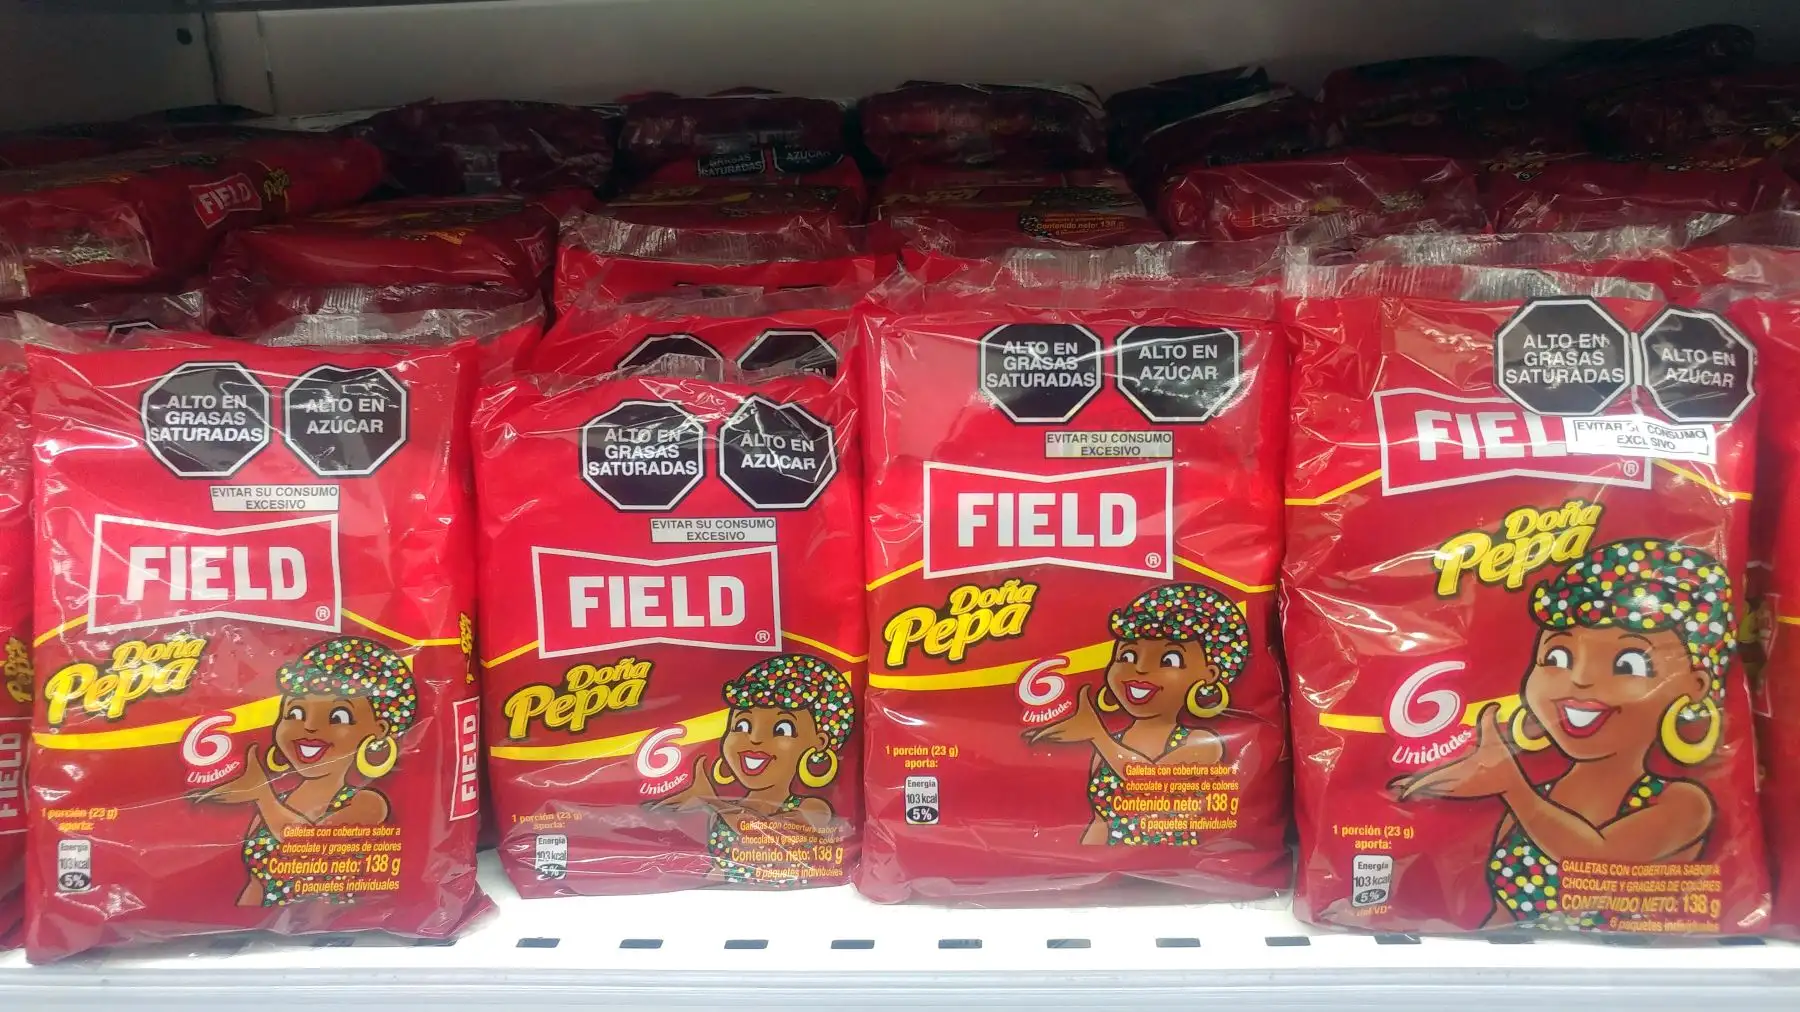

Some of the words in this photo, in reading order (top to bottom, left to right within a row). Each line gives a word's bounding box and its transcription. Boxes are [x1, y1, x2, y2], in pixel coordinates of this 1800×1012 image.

[198, 182, 252, 214] FIELD
[1003, 341, 1048, 355] ALTO
[1054, 342, 1078, 355] EN
[1523, 333, 1572, 349] ALTO
[1579, 333, 1606, 349] EN
[1139, 345, 1188, 360] ALTO
[1192, 345, 1218, 359] EN
[1524, 351, 1605, 366] GRASAS
[1661, 347, 1708, 363] ALTO
[1712, 351, 1736, 366] EN
[1004, 356, 1078, 370] GRASAS
[1140, 362, 1218, 381] AZÚCAR
[1505, 368, 1625, 384] SATURADAS
[986, 373, 1096, 388] SATURADAS
[167, 395, 216, 409] ALTO
[222, 395, 247, 409] EN
[306, 398, 353, 413] ALTO
[358, 398, 385, 413] EN
[165, 411, 246, 426] GRASAS
[306, 415, 384, 434] AZÚCAR
[150, 427, 263, 442] SATURADAS
[604, 428, 651, 443] ALTO
[657, 428, 681, 442] EN
[1047, 433, 1088, 444] EVITAR
[1091, 433, 1107, 444] SU
[1110, 433, 1172, 444] CONSUMO
[1415, 409, 1567, 461] FIEL
[1576, 421, 1623, 431] EVITAR
[1646, 424, 1707, 441] CONSUMO
[740, 433, 786, 449] ALTO
[790, 438, 815, 453] EN
[605, 445, 679, 460] GRASAS
[1080, 446, 1141, 456] EXCESIVO
[588, 461, 698, 476] SATURADAS
[212, 486, 251, 497] EVITAR
[256, 486, 272, 497] SU
[276, 486, 338, 497] CONSUMO
[246, 499, 306, 510] EXCESIVO
[652, 520, 692, 530] EVITAR
[696, 520, 712, 530] SU
[715, 519, 775, 530] CONSUMO
[957, 493, 1137, 547] FIELD
[1504, 501, 1602, 540] Doña
[686, 531, 746, 541] EXCESIVO
[1434, 525, 1596, 596] Pepa
[126, 546, 308, 600] FIELD
[569, 576, 745, 628] FIELD
[949, 580, 1037, 615] Doña
[885, 603, 1031, 666] Pepa
[112, 633, 207, 671] Doña
[566, 657, 652, 690] Doña
[1019, 658, 1067, 706] 6
[45, 659, 199, 725] Pepa
[1389, 660, 1466, 738] 6
[505, 679, 647, 738] Pepa
[1022, 700, 1073, 723] Unidades
[183, 715, 233, 766] 6
[1391, 729, 1473, 766] Unidades
[462, 714, 477, 802] FIELD
[637, 728, 684, 778] 6
[885, 745, 890, 755] 1
[893, 745, 929, 758] porción
[931, 745, 947, 758] (23
[948, 745, 959, 758] g)
[187, 760, 240, 784] Unidades
[905, 759, 938, 770] aporta:
[1126, 765, 1156, 776] Galletas
[1157, 766, 1171, 776] con
[1172, 764, 1209, 776] cobertura
[1210, 765, 1231, 776] sabor
[0, 733, 22, 818] FIELD
[640, 773, 688, 795] Unidades
[907, 779, 936, 789] Energía
[1126, 780, 1162, 791] chocolate
[1163, 782, 1168, 793] y
[1169, 781, 1196, 793] grageas
[1197, 780, 1211, 791] de
[1212, 780, 1238, 791] colores
[906, 793, 921, 804] 103
[921, 793, 938, 804] kcal
[1113, 795, 1170, 812] Contenido
[1173, 796, 1202, 812] neto:
[1205, 793, 1227, 811] 138
[1230, 795, 1239, 815] g
[912, 808, 932, 820] 5%
[284, 827, 315, 838] Galletas
[316, 829, 331, 838] con
[333, 826, 371, 837] cobertura
[372, 826, 393, 837] sabor
[395, 828, 401, 836] a
[1140, 818, 1146, 830] 6
[1148, 818, 1188, 832] paquetes
[1189, 817, 1237, 830] individuales
[1333, 825, 1338, 835] 1
[1341, 825, 1381, 838] porción
[1384, 826, 1401, 838] (23
[1403, 826, 1414, 840] g)
[282, 843, 321, 854] chocolate
[322, 845, 328, 855] y
[329, 843, 361, 855] grageas
[362, 842, 371, 853] de
[373, 842, 402, 853] colores
[538, 837, 566, 846] Energía
[1355, 839, 1392, 850] aporta:
[731, 847, 783, 862] Contenido
[786, 848, 810, 862] neto:
[812, 845, 833, 861] 138
[835, 847, 844, 864] g
[269, 858, 328, 875] Contenido
[331, 858, 361, 874] neto:
[365, 855, 389, 873] 138
[392, 857, 401, 876] g
[1358, 861, 1389, 871] Energía
[1562, 860, 1608, 875] GALLETAS
[1609, 864, 1630, 876] CON
[1631, 864, 1682, 877] COBERTURA
[65, 874, 84, 886] 5%
[294, 881, 301, 892] 6
[302, 881, 344, 894] paquetes
[346, 880, 400, 891] individuales
[1353, 876, 1371, 887] 103
[1372, 874, 1392, 886] kcal
[1562, 877, 1617, 892] CHOCOLATE
[1619, 880, 1626, 892] Y
[1627, 881, 1667, 893] GRAGEAS
[1668, 881, 1680, 892] DE
[1360, 891, 1380, 903] 5%
[1562, 894, 1639, 912] CONTENIDO
[1640, 897, 1678, 912] NETO:
[1683, 894, 1707, 914] 138
[1710, 898, 1721, 918] g
